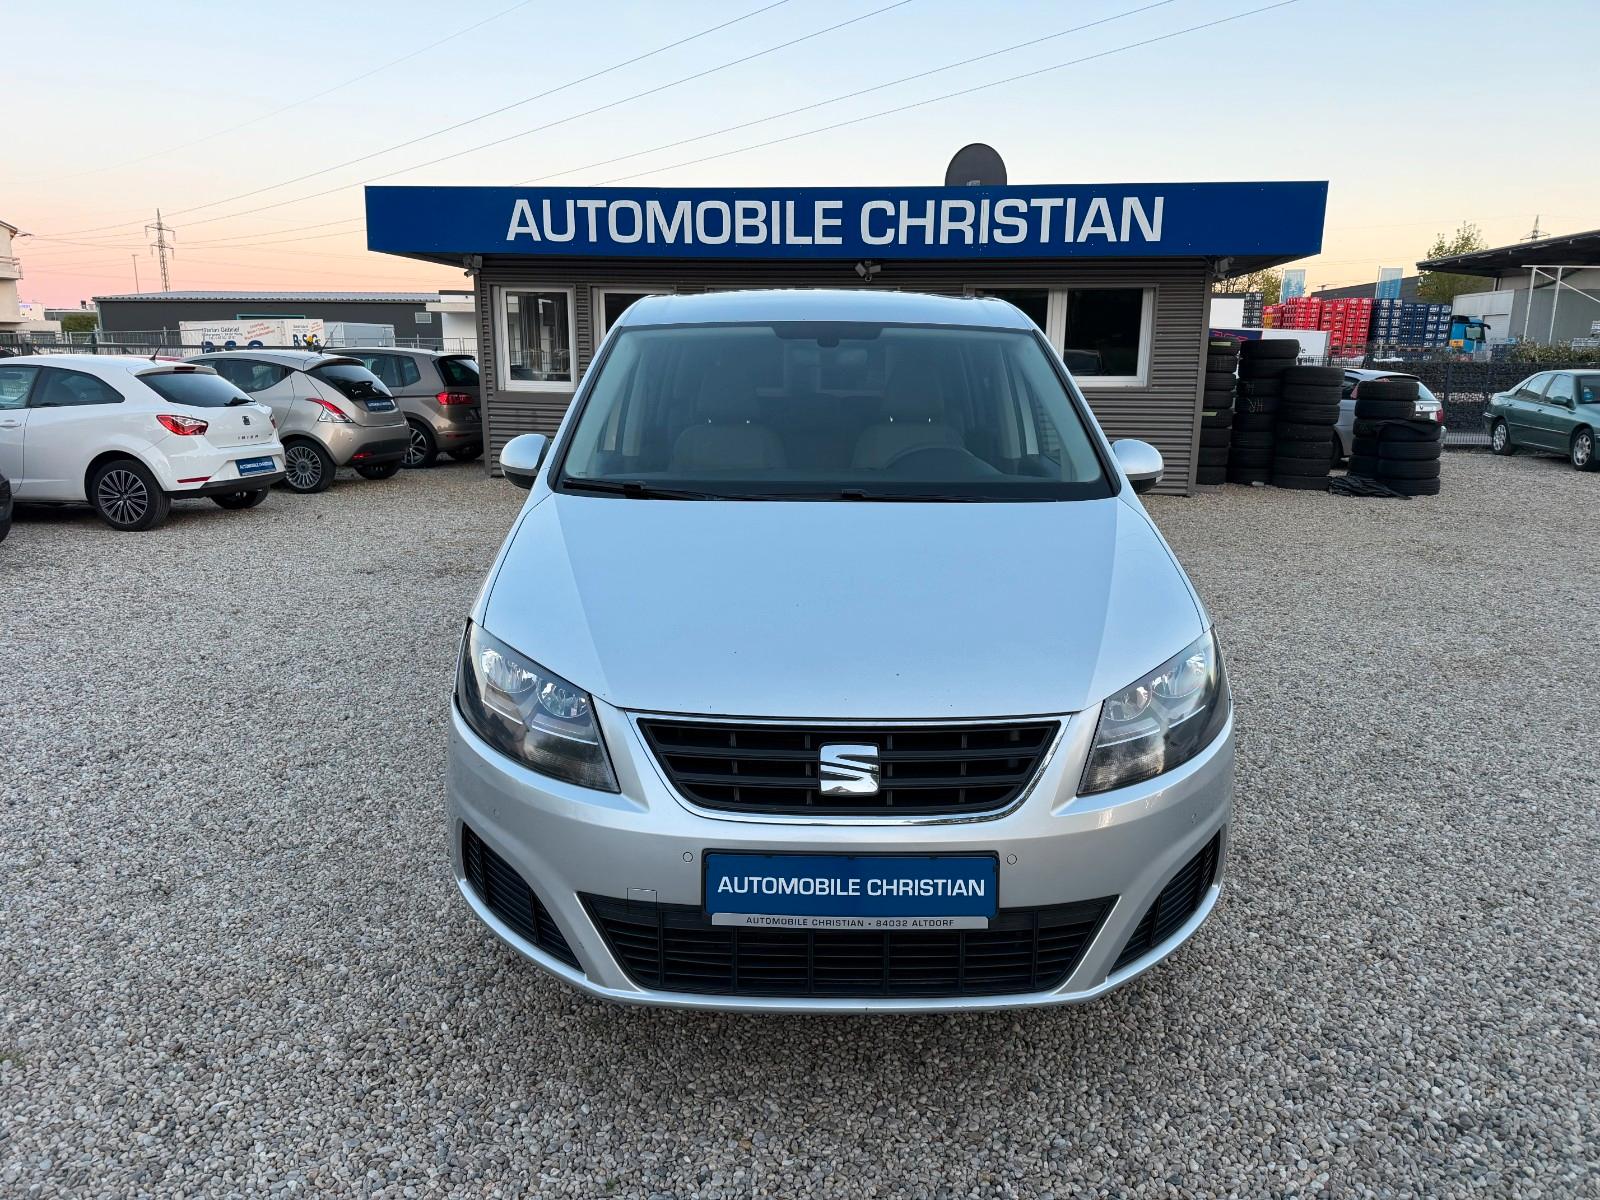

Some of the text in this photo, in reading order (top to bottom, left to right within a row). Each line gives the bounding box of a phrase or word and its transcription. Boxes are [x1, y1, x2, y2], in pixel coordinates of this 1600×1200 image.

[506, 196, 1165, 245] AUTOMOBILE CHRISTIAN
[717, 876, 985, 897] AUTOMOBILE CHRISTIAN
[746, 917, 808, 926] AUTOMOBILE
[811, 918, 864, 927] CHRISTIAN
